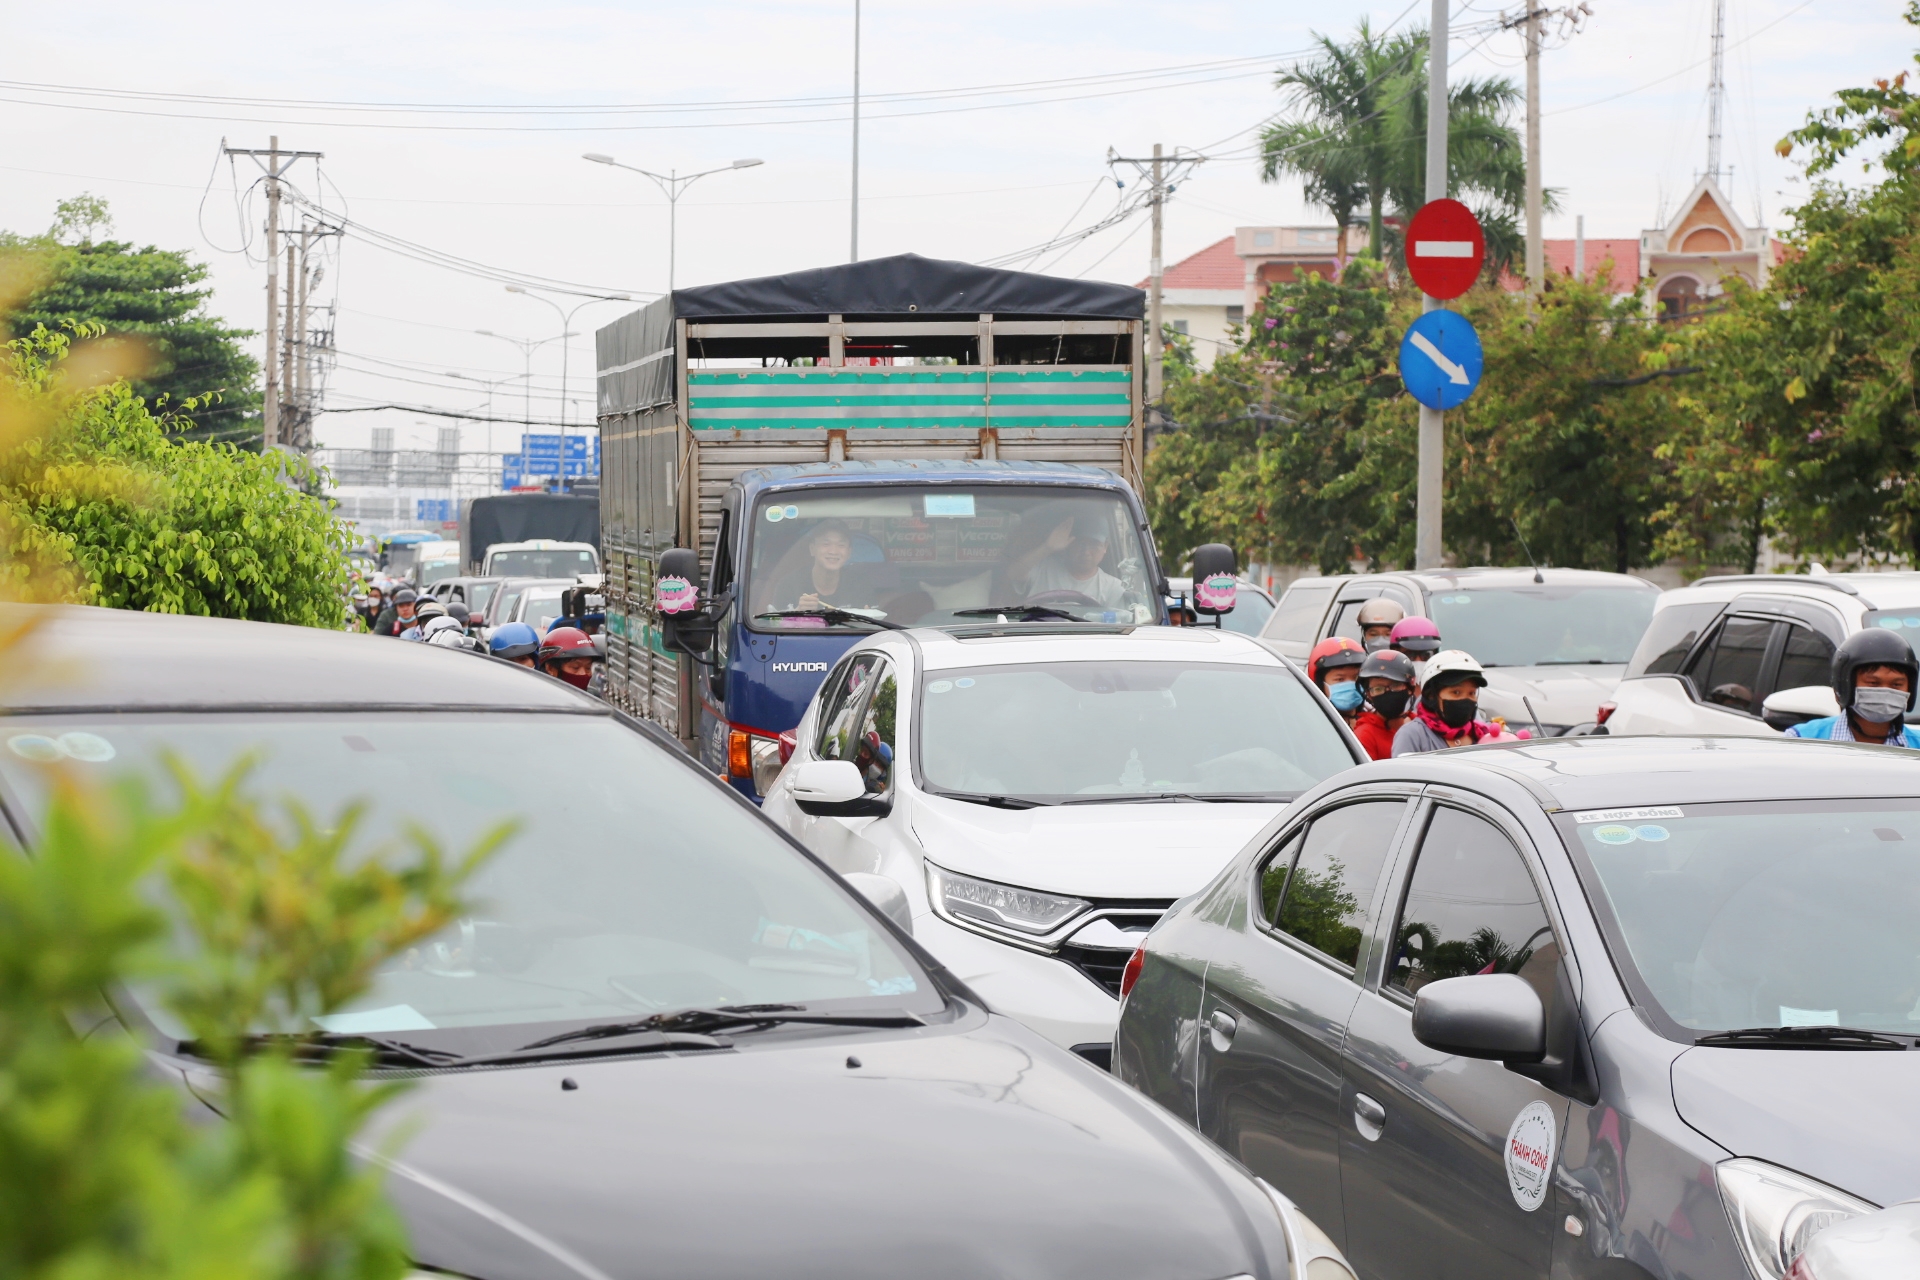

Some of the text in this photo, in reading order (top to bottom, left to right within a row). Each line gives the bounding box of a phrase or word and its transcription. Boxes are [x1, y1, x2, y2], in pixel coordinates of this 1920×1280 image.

[772, 662, 827, 672] HYUNDAI
[1603, 811, 1633, 819] HỢP
[1529, 1146, 1548, 1170] CÔNG
